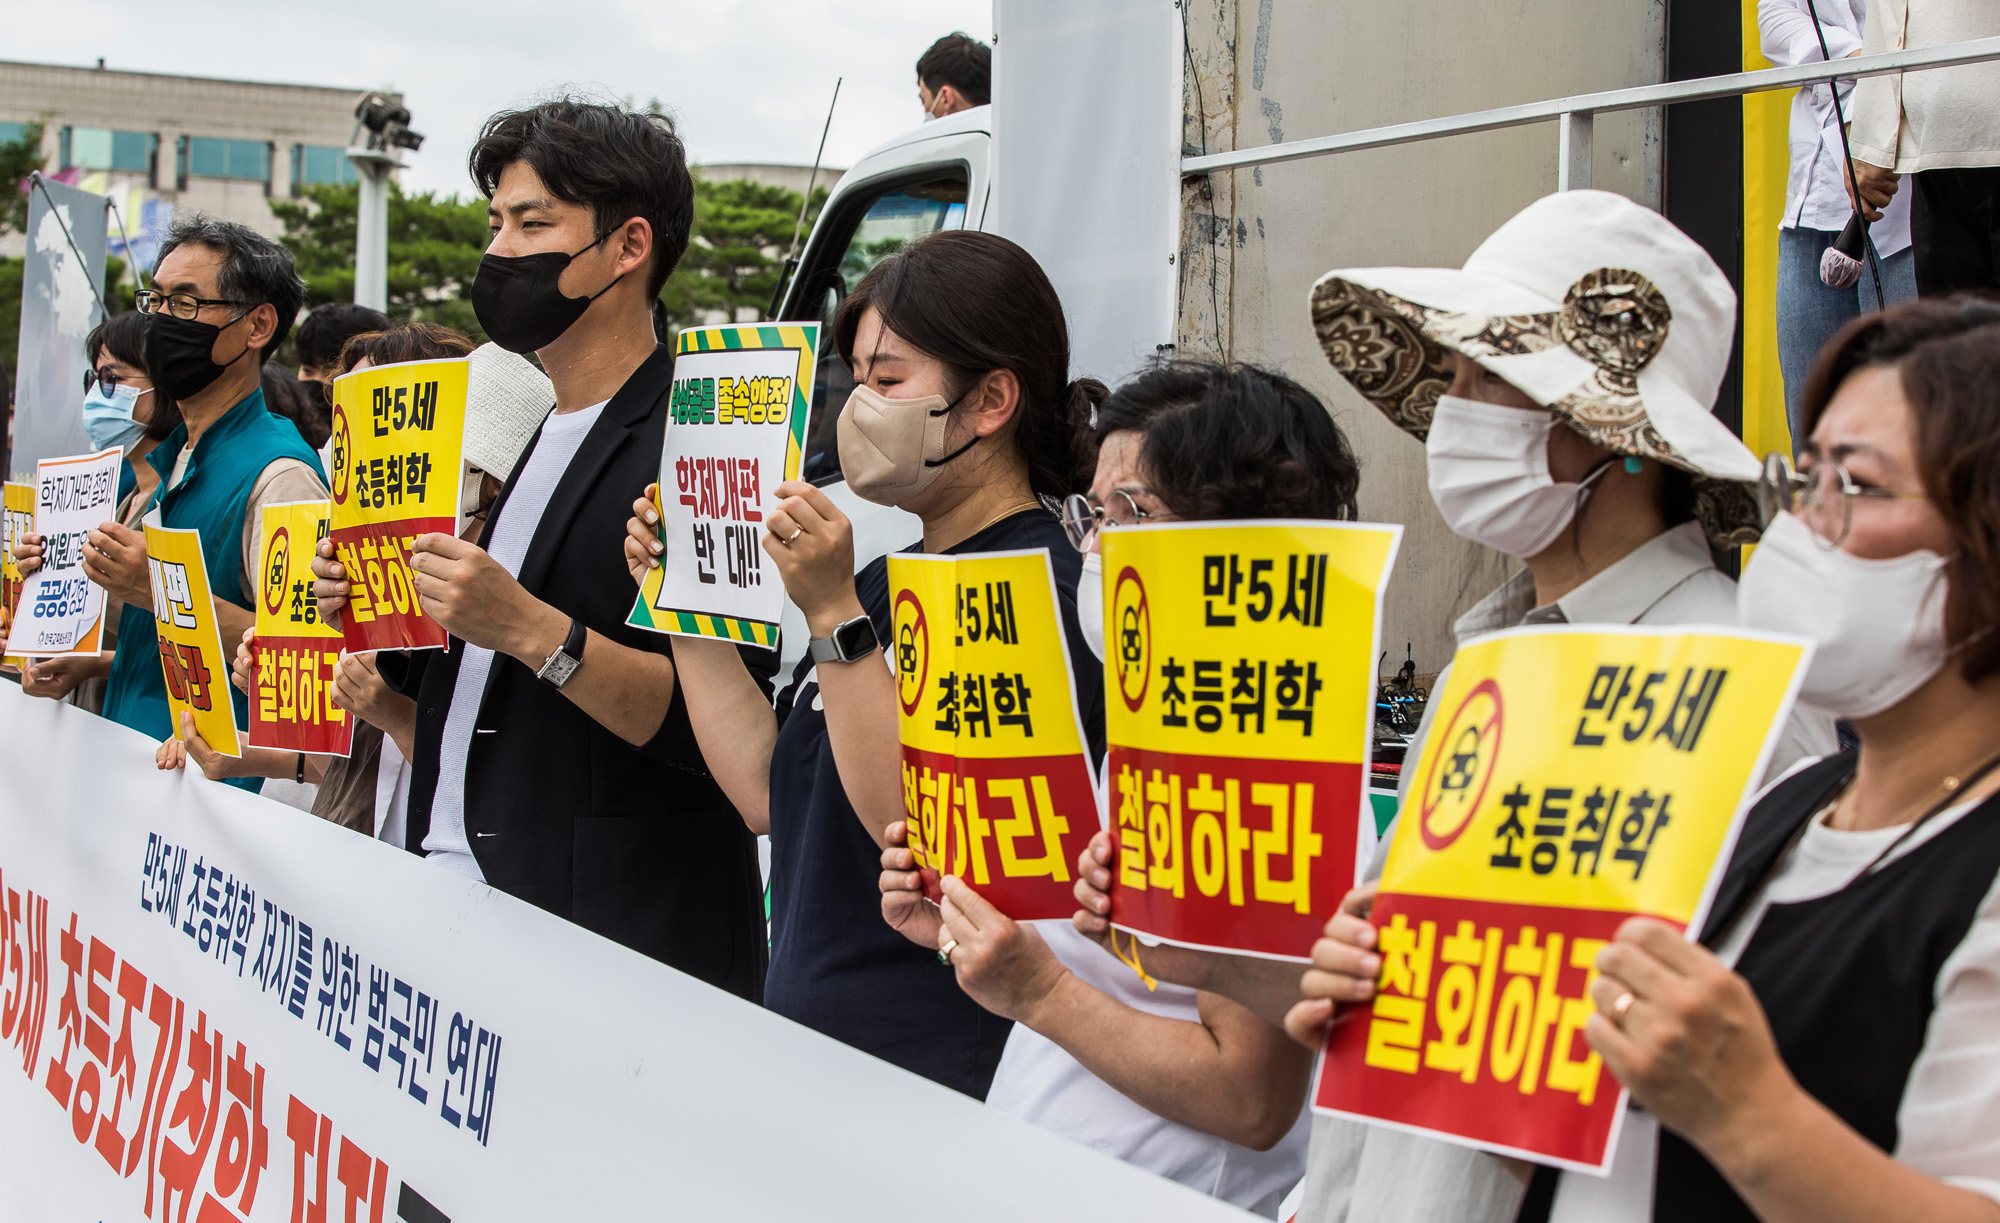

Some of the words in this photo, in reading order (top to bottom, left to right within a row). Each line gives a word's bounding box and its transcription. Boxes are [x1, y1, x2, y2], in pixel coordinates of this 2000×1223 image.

[372, 381, 438, 437] 만5세
[718, 375, 791, 425] 졸속행정
[355, 452, 431, 509] 초등취학
[675, 455, 763, 522] 학제개편
[336, 533, 425, 623] 철회하
[693, 522, 716, 584] 반
[725, 524, 761, 589] 대!!
[1203, 554, 1329, 628] 만5세
[290, 579, 323, 625] 초등
[935, 671, 1034, 738] 초취학
[1160, 656, 1323, 737] 초등취학
[1570, 663, 1729, 754] 만5세
[1118, 764, 1323, 914] 철회하라
[1489, 782, 1672, 881] 초등취학
[0, 867, 48, 1081] 5세
[141, 831, 187, 929] 만5세
[182, 855, 255, 978] 초등취학
[252, 898, 313, 1020] 저지를
[317, 936, 361, 1052] 위한
[362, 964, 438, 1106] 범국민
[440, 1011, 502, 1148] 연대
